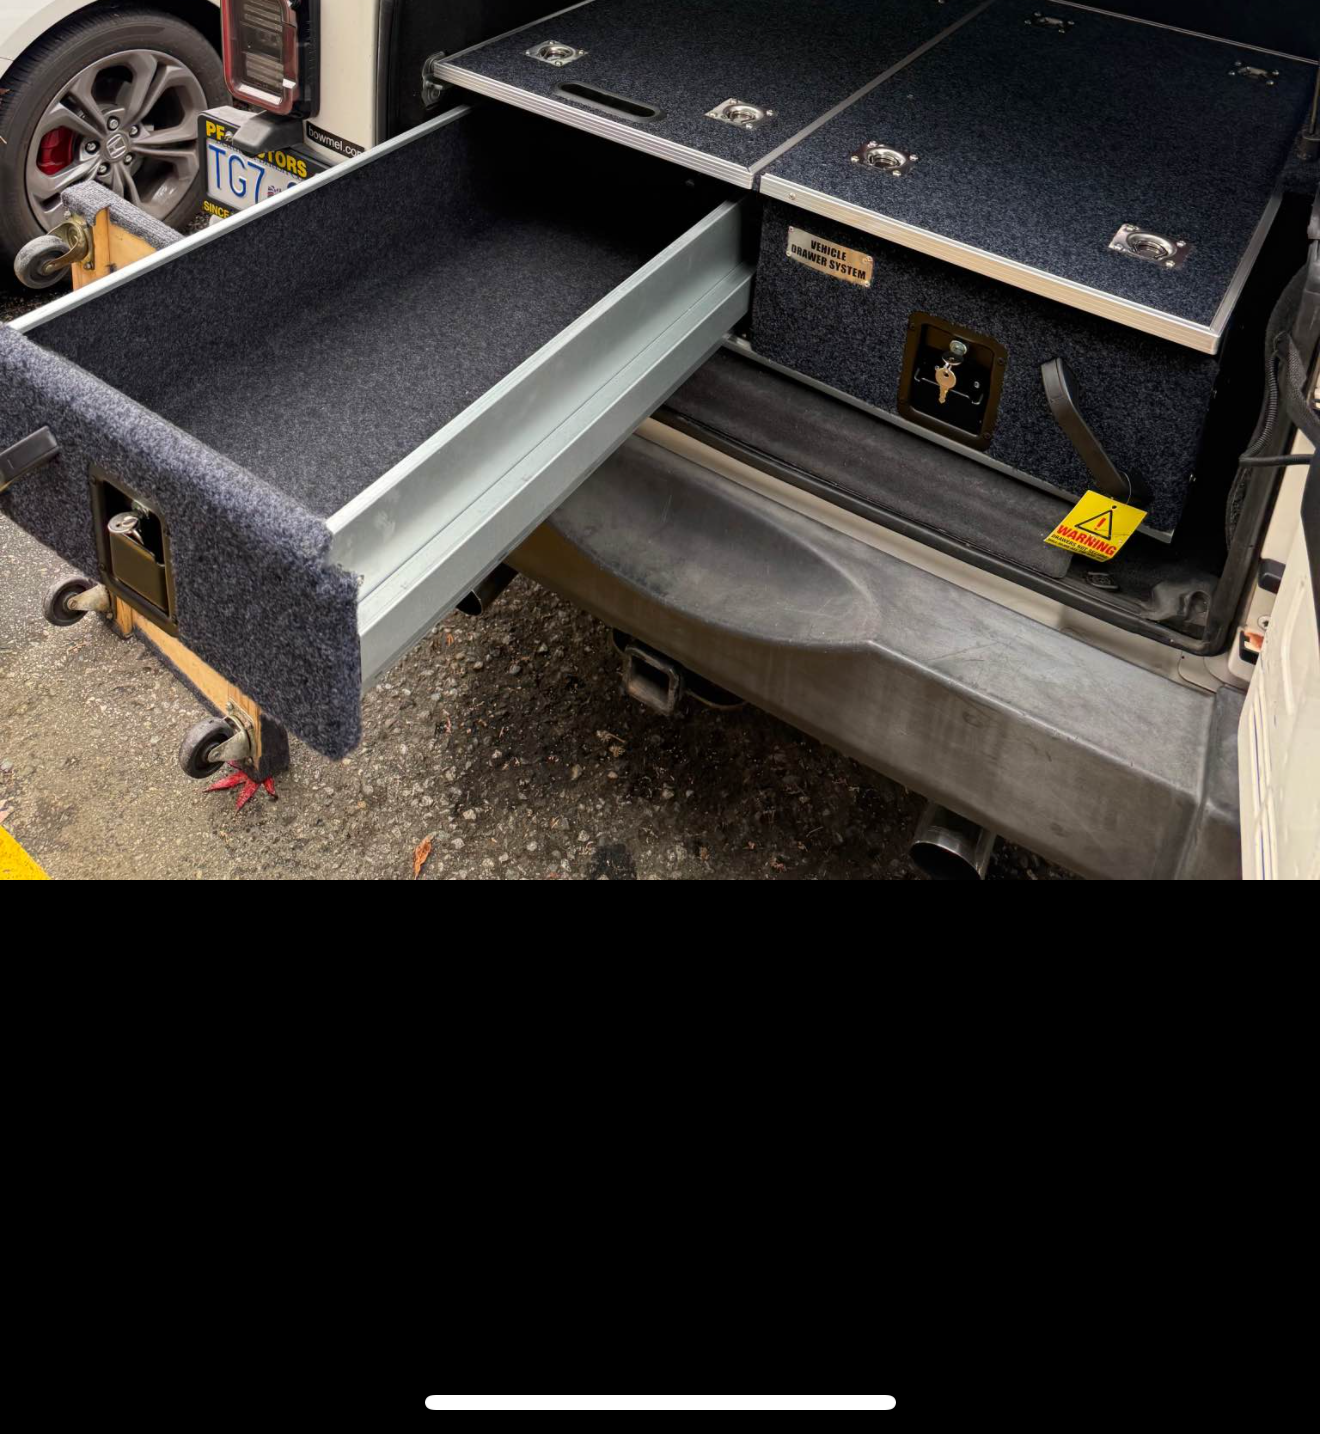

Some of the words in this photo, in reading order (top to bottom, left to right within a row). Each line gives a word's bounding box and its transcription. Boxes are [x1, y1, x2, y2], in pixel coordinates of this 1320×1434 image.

[791, 244, 828, 267] DRAWER
[829, 259, 867, 280] SYSTEM
[810, 239, 847, 262] VEHICLE
[1057, 524, 1117, 556] WARNING
